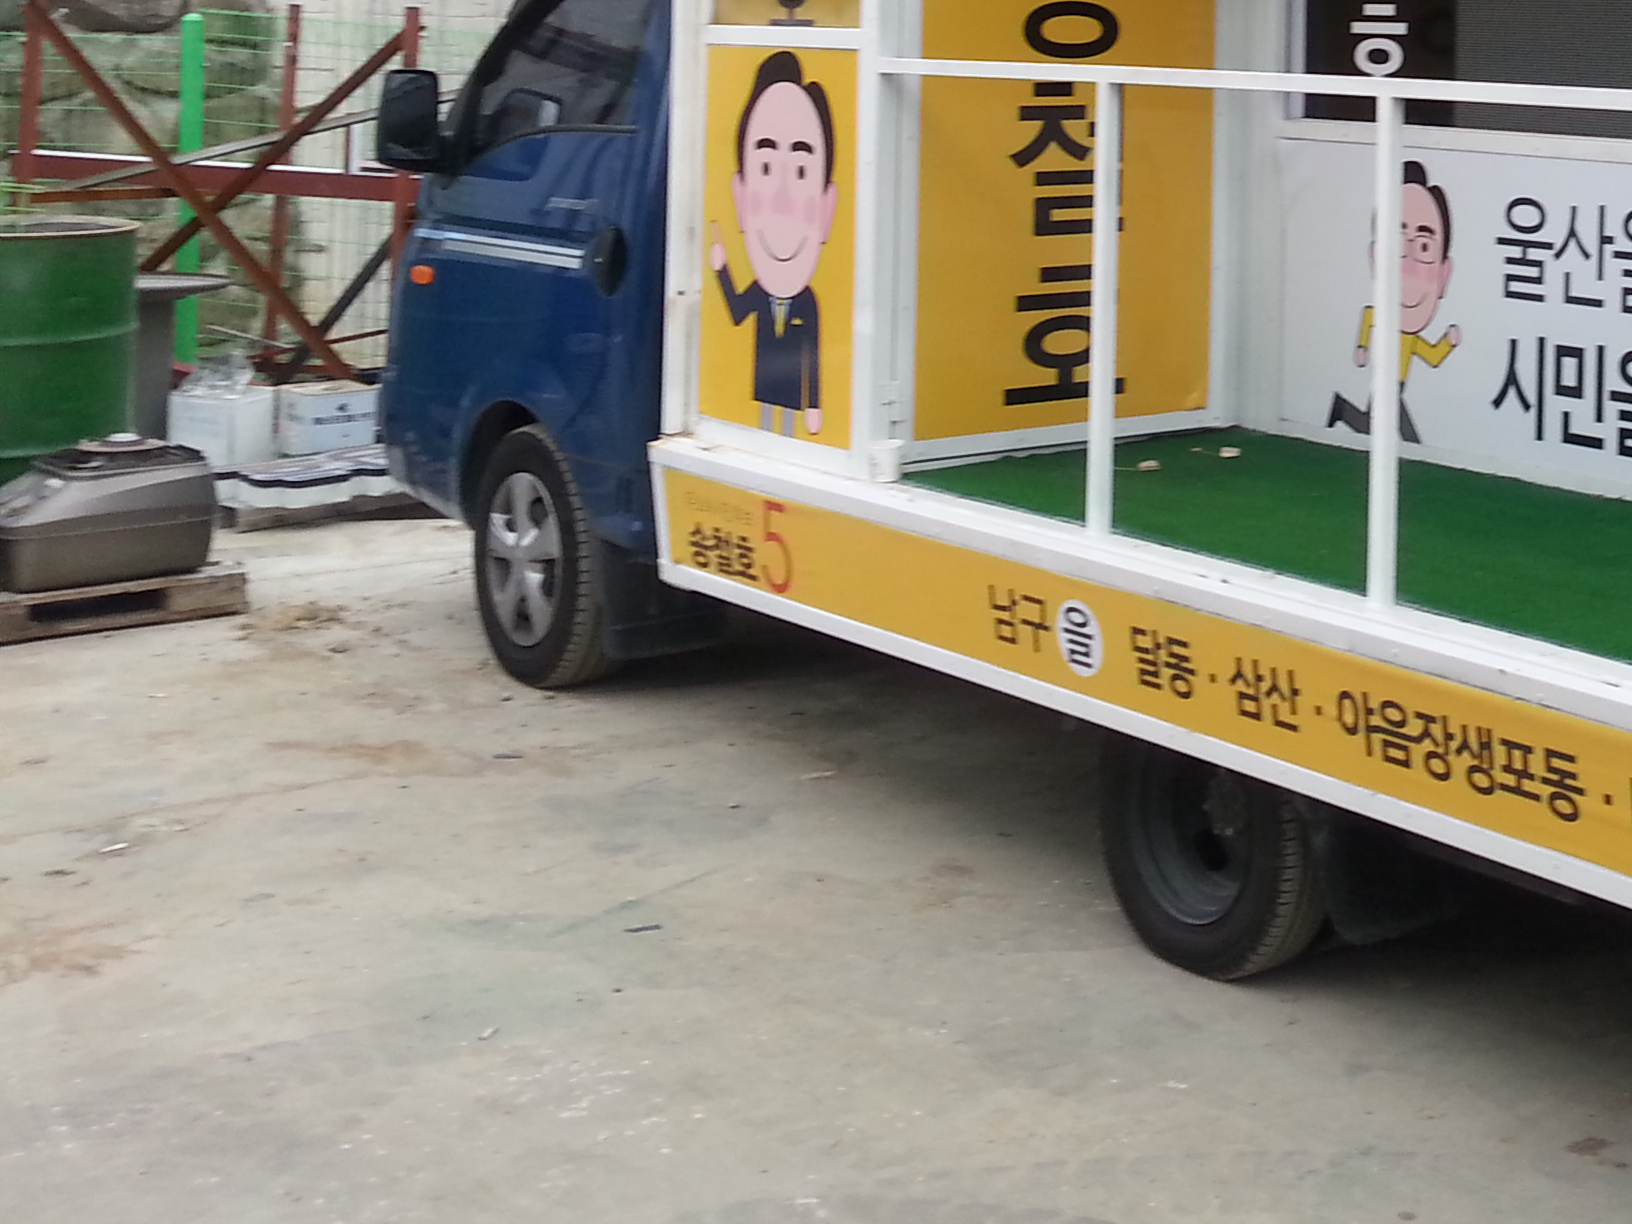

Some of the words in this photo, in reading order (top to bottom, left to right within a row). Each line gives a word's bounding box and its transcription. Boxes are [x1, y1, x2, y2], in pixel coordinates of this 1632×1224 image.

[760, 498, 794, 595] 5
[1130, 625, 1196, 701] 달동
[1229, 656, 1302, 733] 삼산
